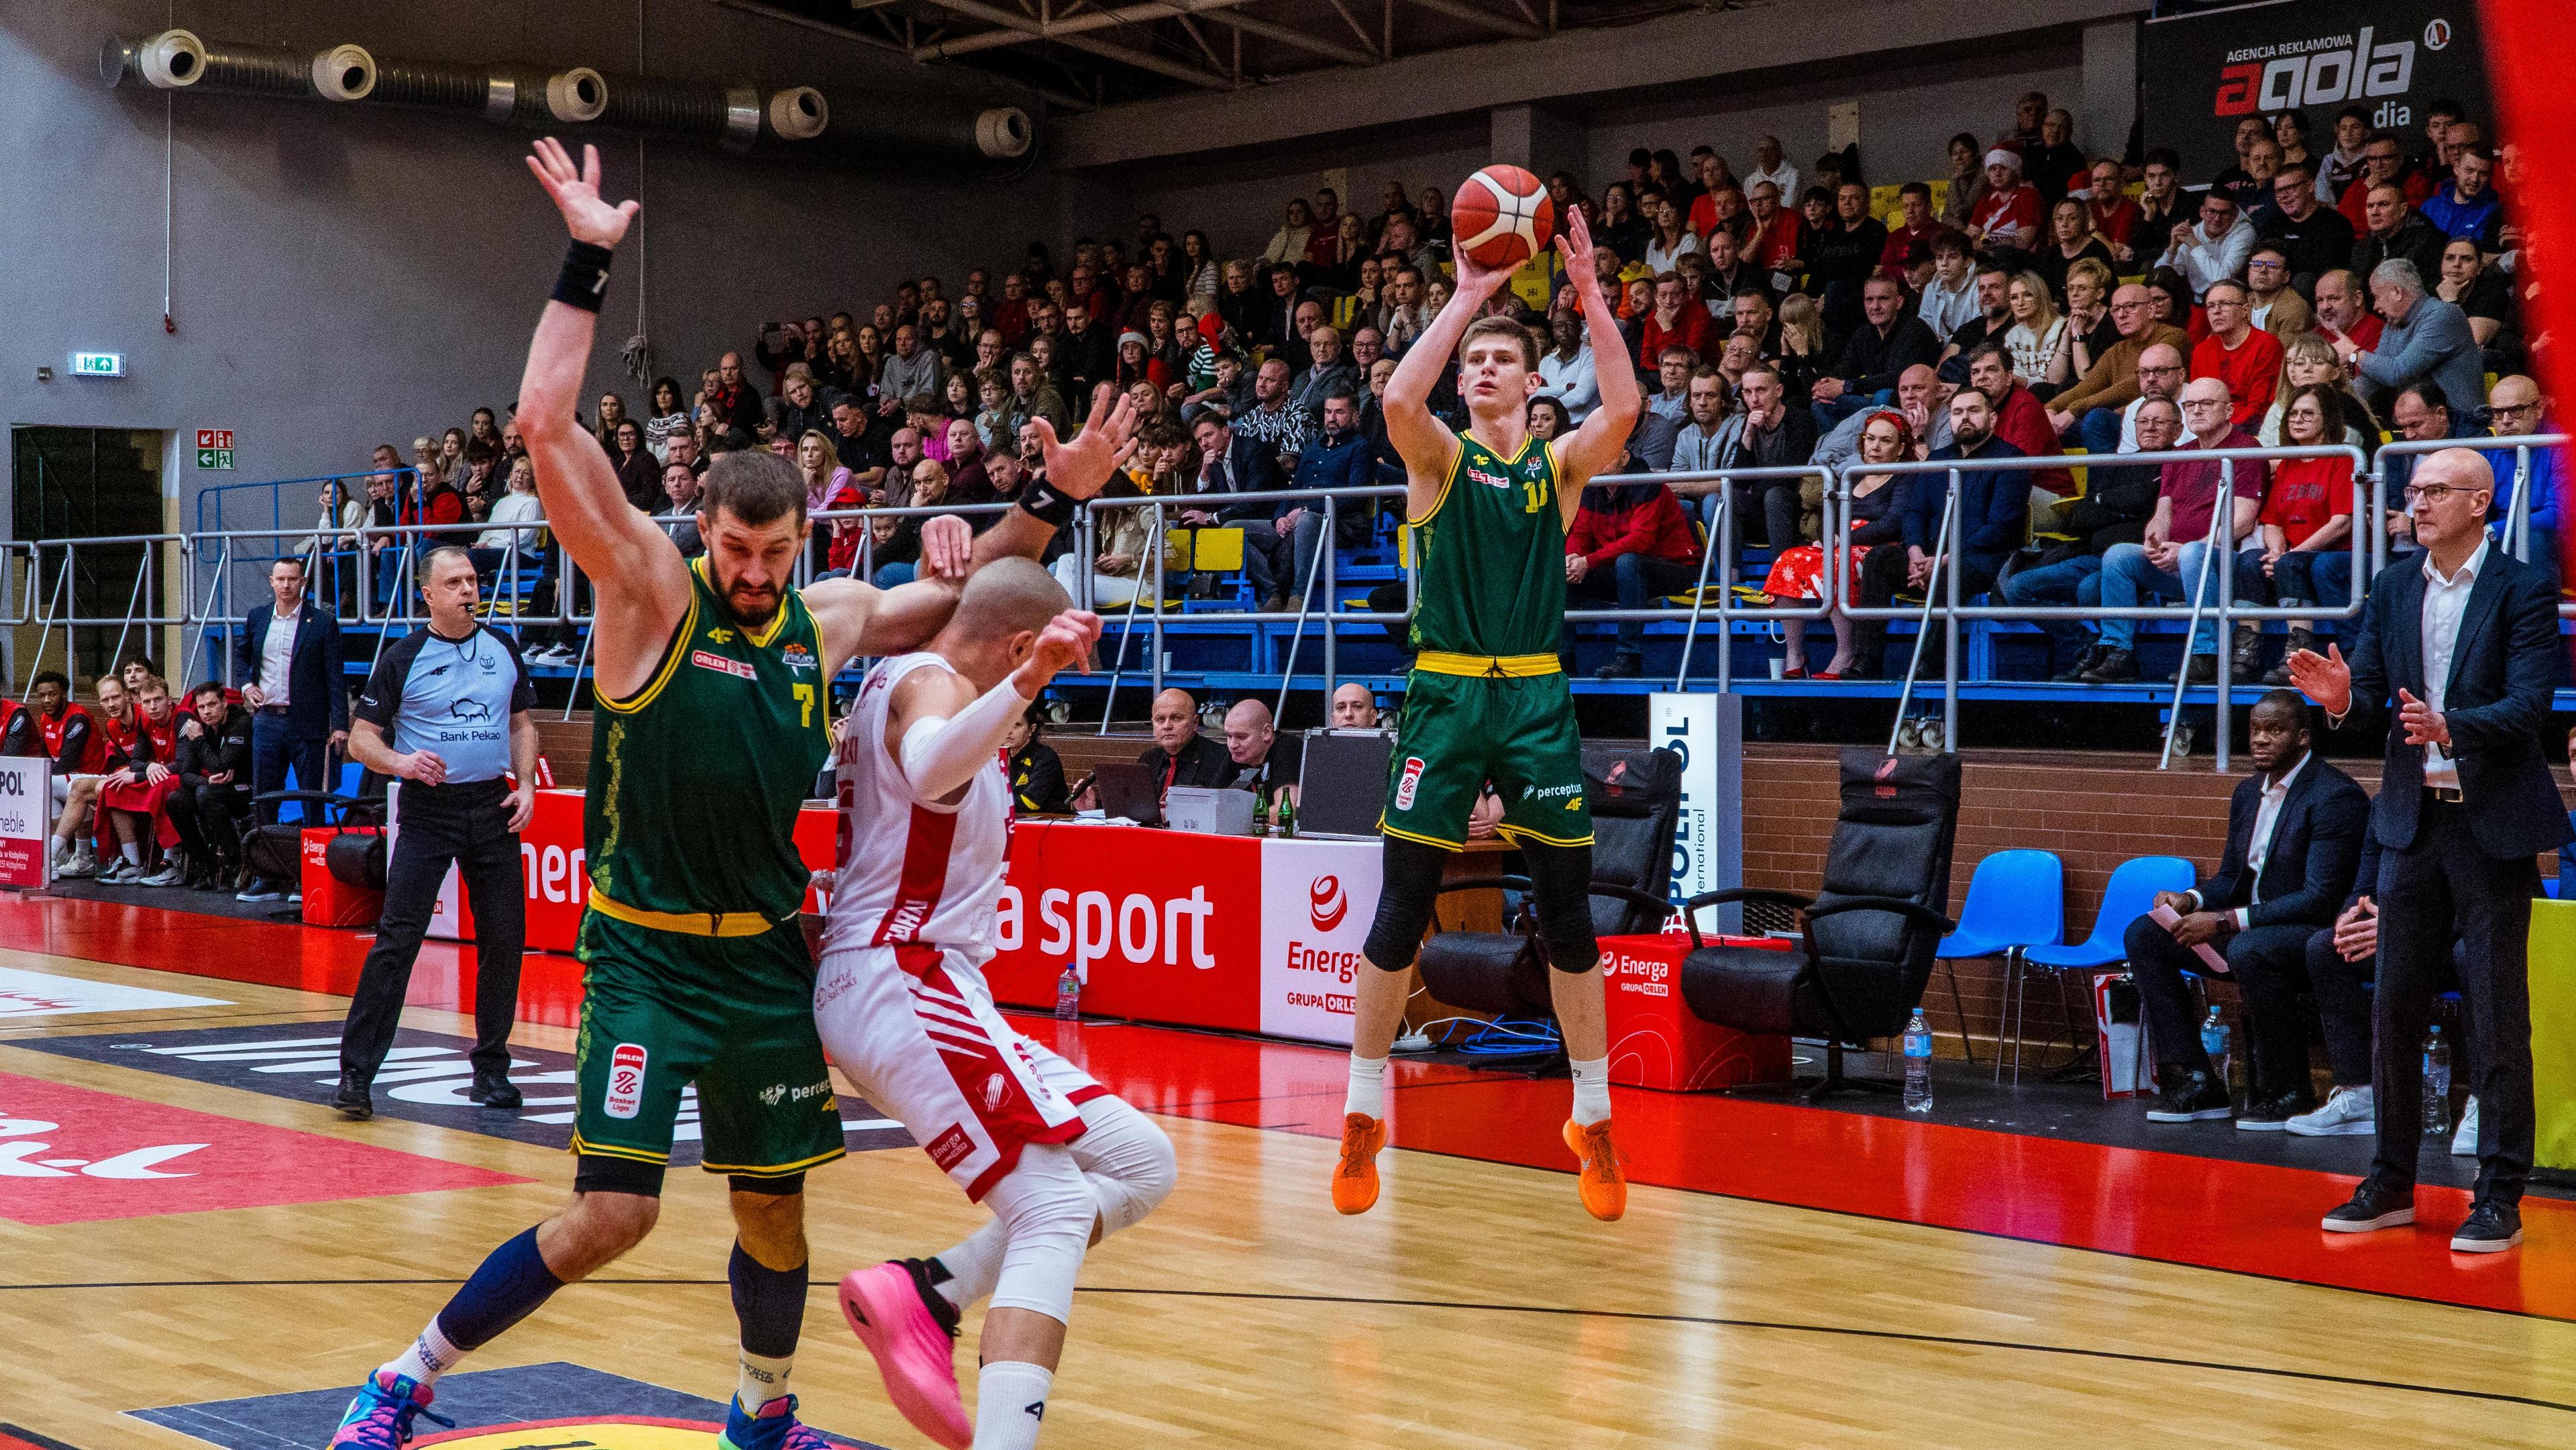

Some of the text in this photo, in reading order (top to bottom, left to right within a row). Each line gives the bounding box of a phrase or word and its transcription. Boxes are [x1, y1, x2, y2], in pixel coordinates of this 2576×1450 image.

[2226, 34, 2353, 63] AGENCJA REKLAMOWA
[591, 270, 608, 294] 7
[1030, 489, 1055, 510] 7
[707, 627, 735, 645] 4F
[694, 654, 727, 669] ORLEN
[429, 665, 449, 676] 4F
[792, 682, 815, 728] 7
[440, 729, 500, 742] Bank Pekao
[1407, 764, 1422, 772] ORLEN
[1537, 783, 1582, 800] perceptus
[1565, 797, 1582, 811] 4F
[1040, 884, 1216, 986] sport
[1620, 955, 1668, 982] Energa
[1620, 982, 1667, 995] GRUPA ORLEN
[1287, 992, 1356, 1013] GRUPA ORLE
[615, 1053, 643, 1062] ORLEN
[791, 1078, 832, 1102] percep
[608, 1096, 636, 1106] Basket
[612, 1104, 630, 1112] Liga
[932, 1133, 961, 1159] Energa
